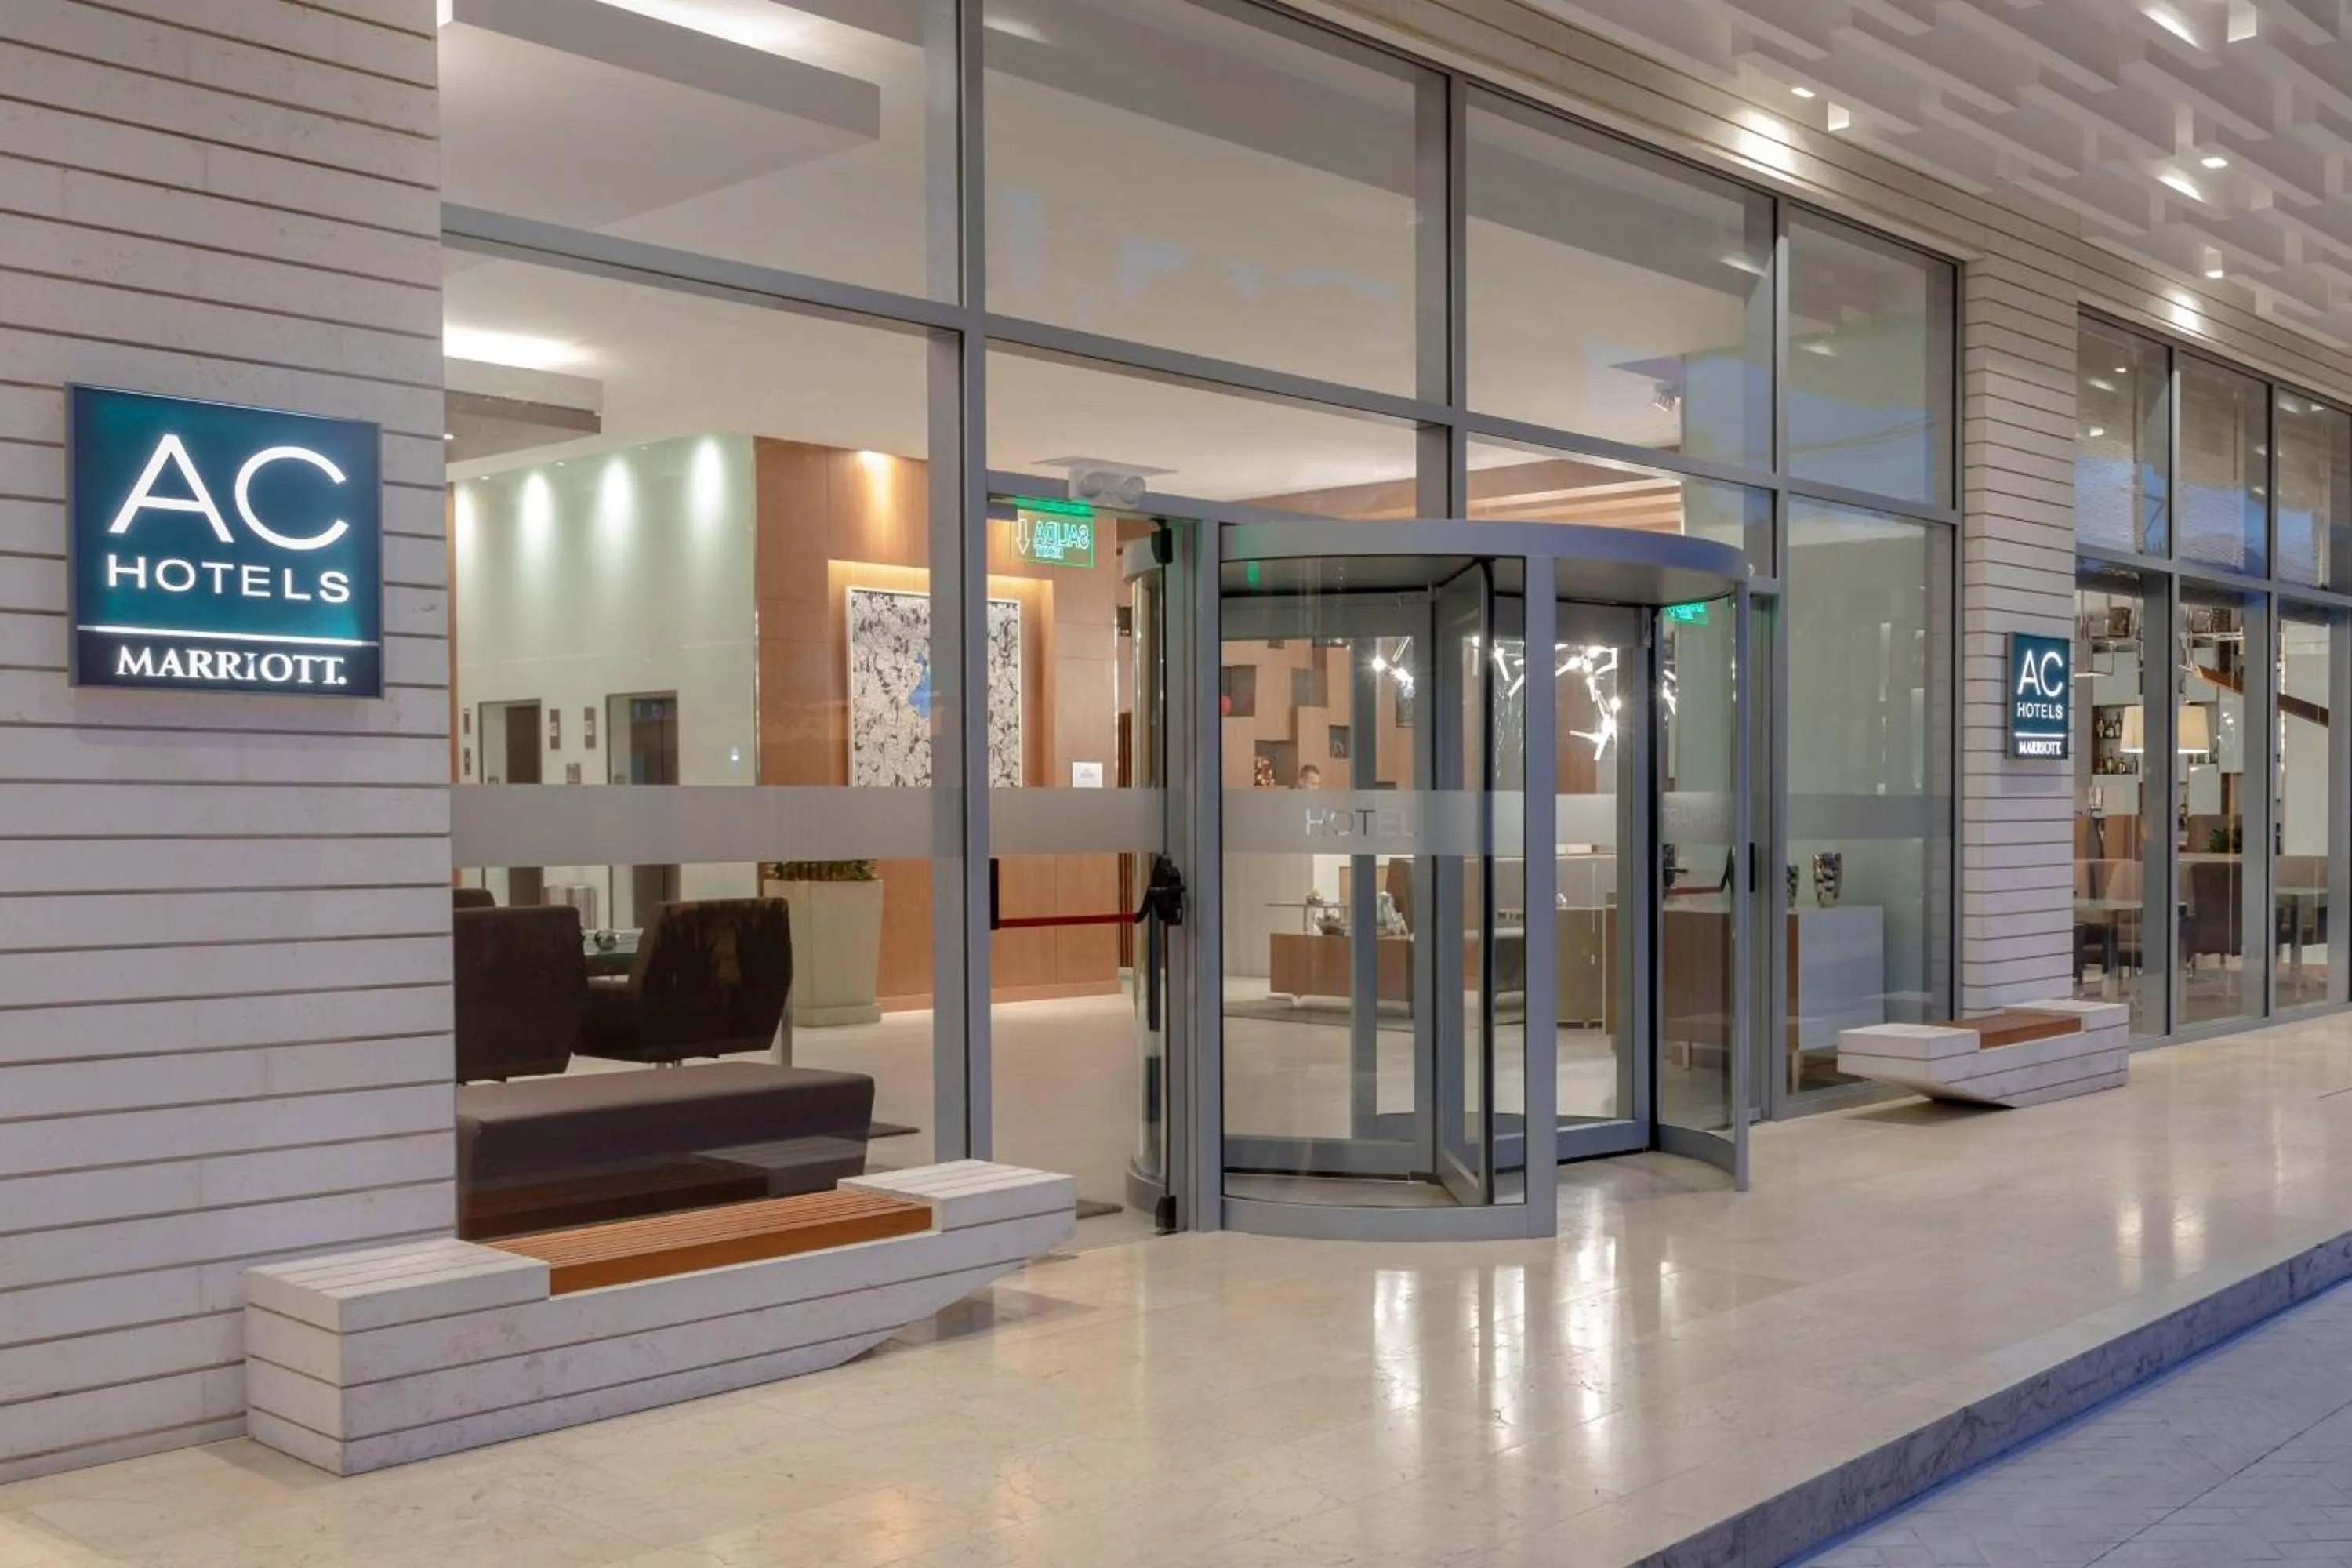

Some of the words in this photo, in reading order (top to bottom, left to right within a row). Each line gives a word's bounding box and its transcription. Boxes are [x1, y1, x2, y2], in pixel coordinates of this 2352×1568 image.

[108, 433, 350, 550] AC
[107, 554, 350, 604] HOTELS
[2017, 649, 2063, 697] AC
[2016, 702, 2063, 720] HOTELS
[1305, 808, 1417, 837] HOTEL
